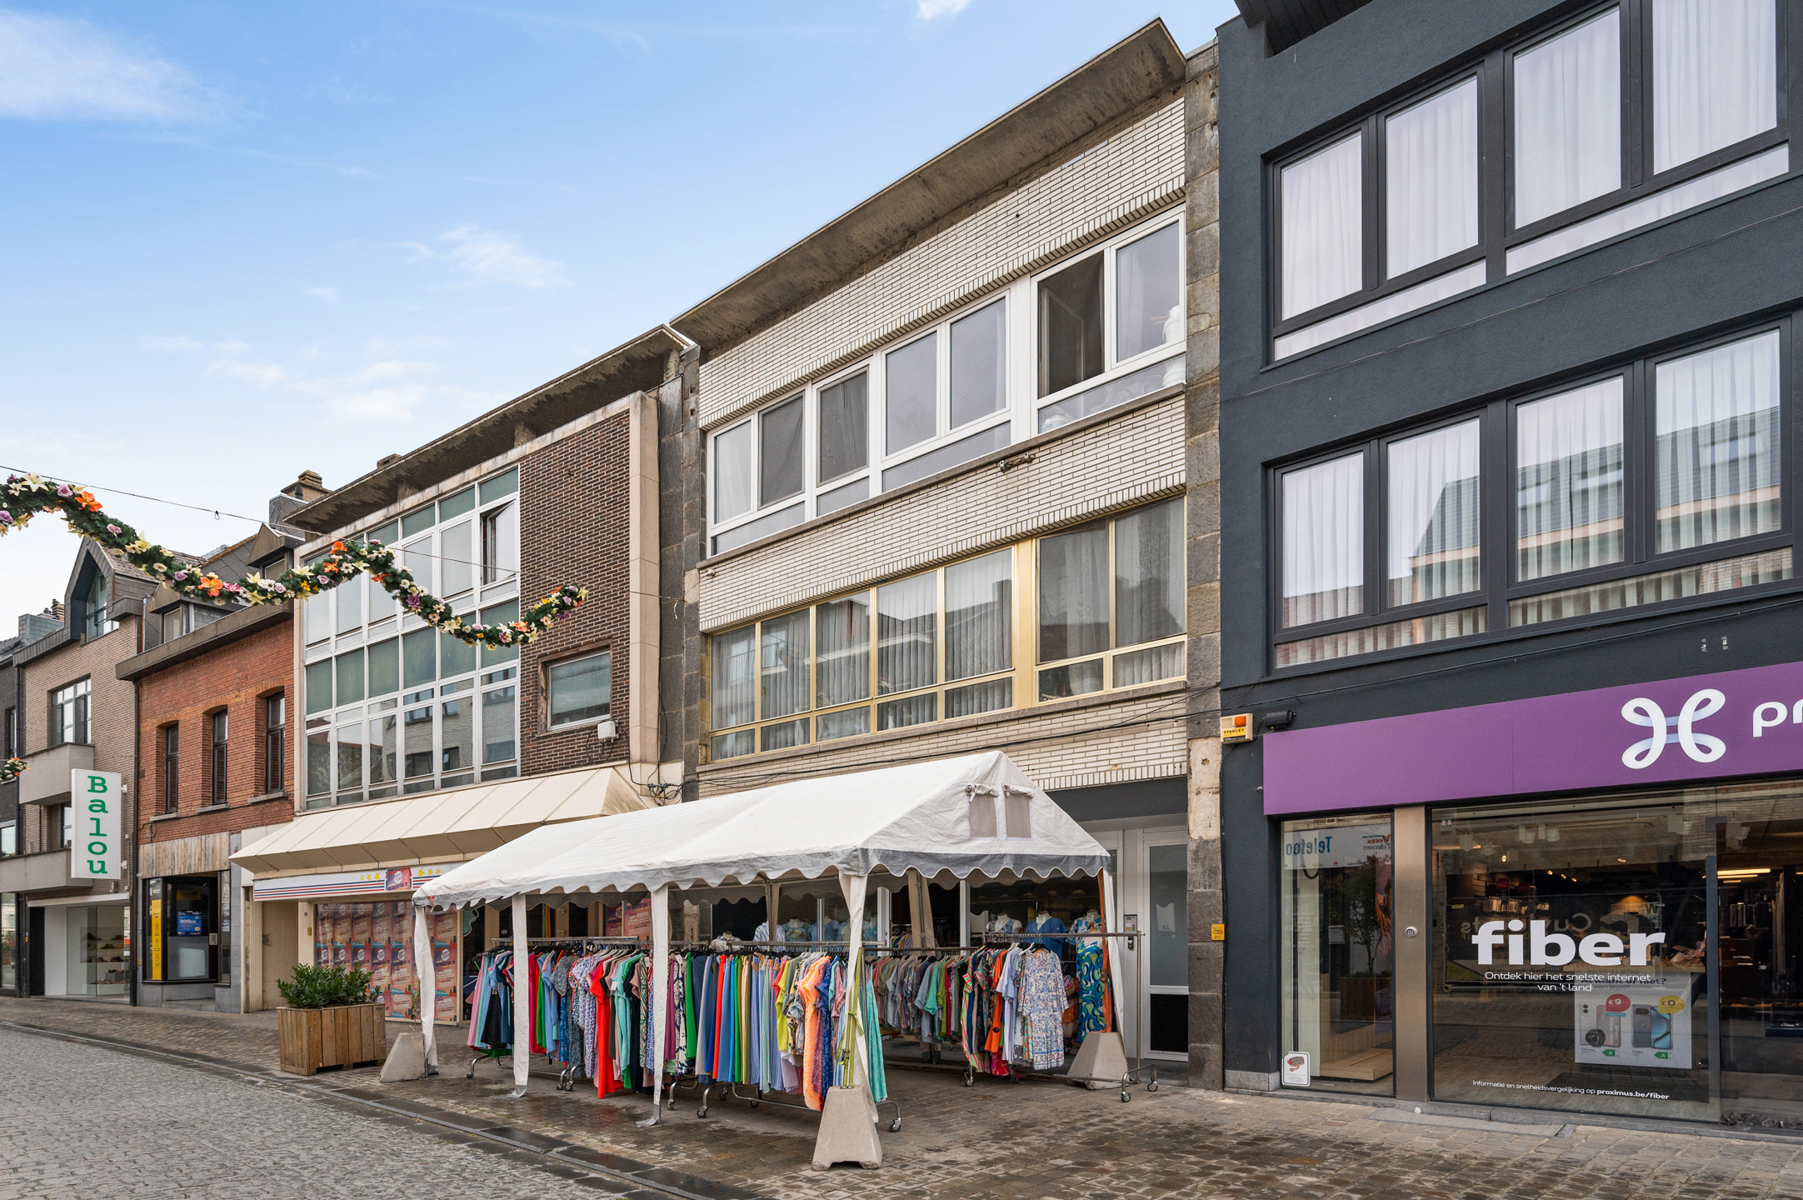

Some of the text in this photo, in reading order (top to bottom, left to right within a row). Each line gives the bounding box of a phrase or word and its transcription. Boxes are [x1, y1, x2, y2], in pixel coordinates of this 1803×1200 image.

[87, 775, 109, 875] Balou
[1472, 919, 1667, 966] fiber
[1485, 971, 1522, 980] Ontdek
[1523, 971, 1543, 980] hier
[1545, 972, 1563, 981] het
[1565, 972, 1605, 981] snelste
[1607, 972, 1651, 982] internet
[1568, 983, 1593, 992] land
[1472, 1080, 1505, 1088] Informatie
[1516, 1083, 1585, 1094] snelheidsvergelijking
[1597, 1089, 1670, 1100] proximus.be/fiber
